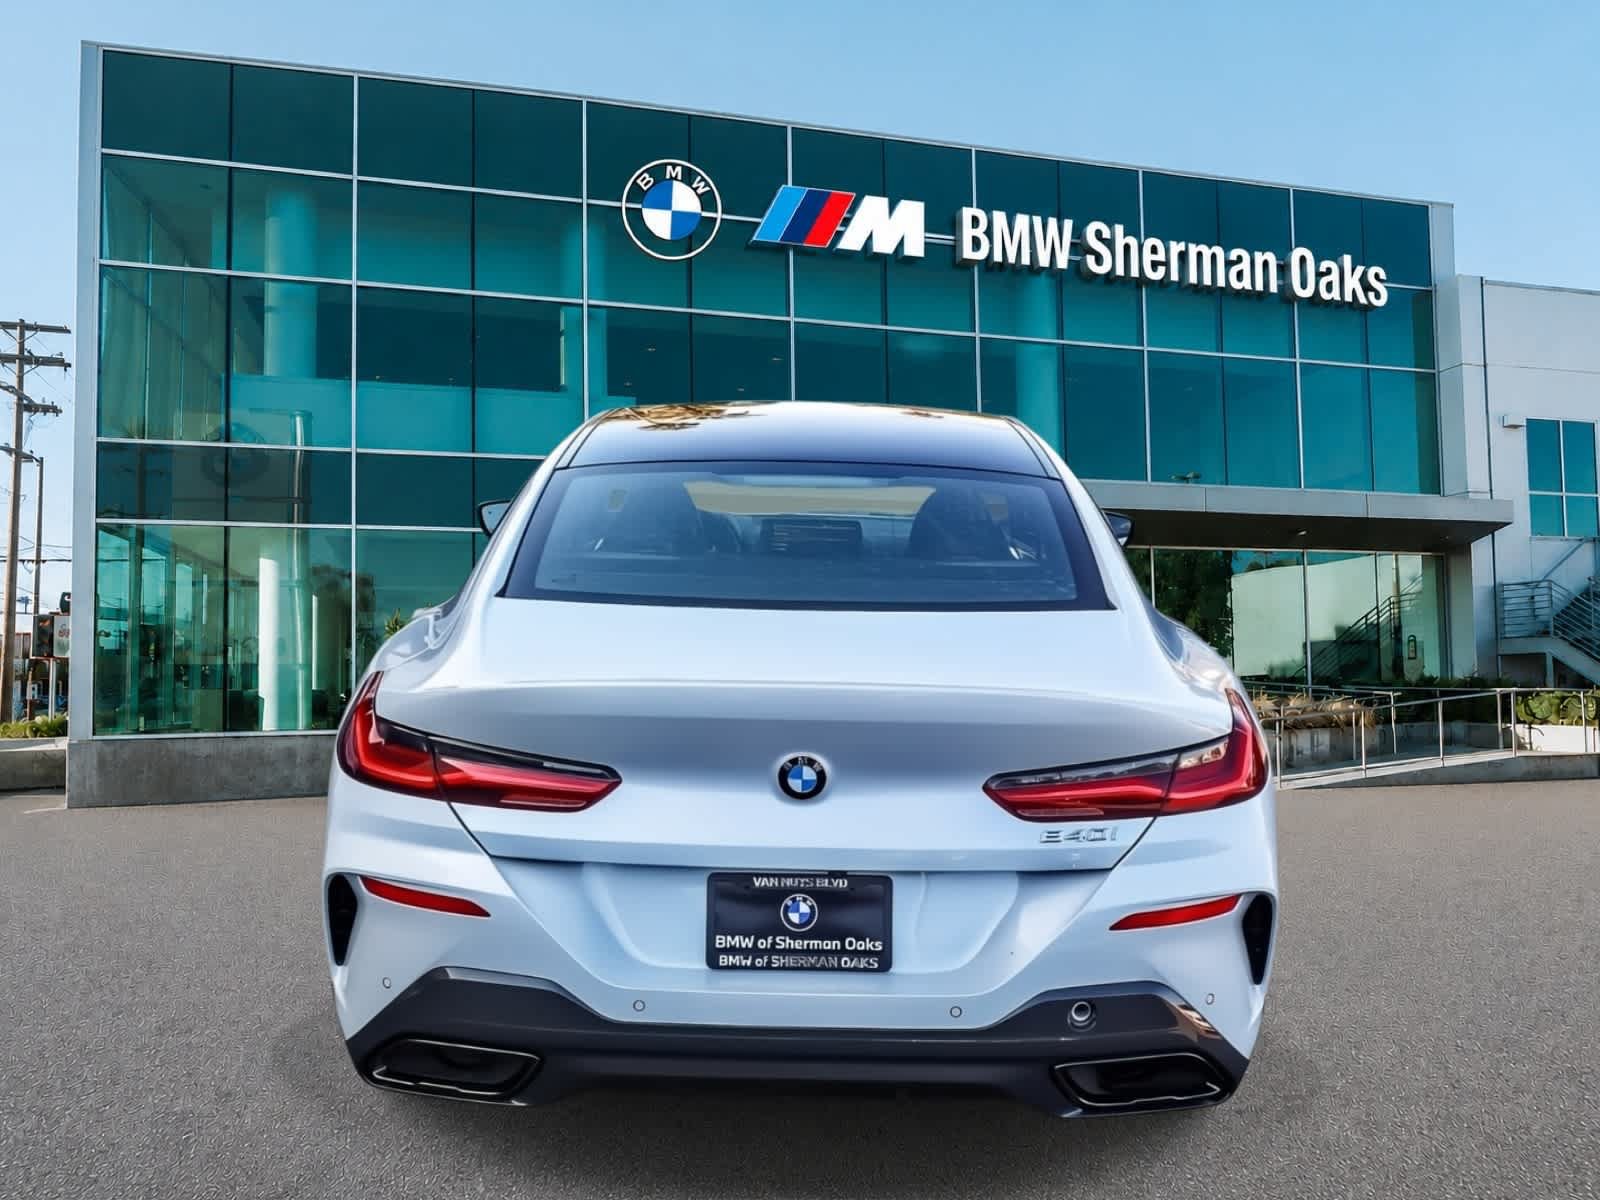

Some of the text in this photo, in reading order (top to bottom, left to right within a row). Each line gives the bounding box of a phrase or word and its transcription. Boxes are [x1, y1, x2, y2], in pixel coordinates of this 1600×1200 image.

[636, 165, 711, 194] BMW
[961, 205, 1388, 307] BMW Sherman Oaks
[752, 876, 779, 888] VAN
[816, 878, 849, 889] BLVD
[715, 934, 884, 951] BMW of Sherman Oaks
[719, 954, 879, 969] BMW of SHERMAN OAKS
